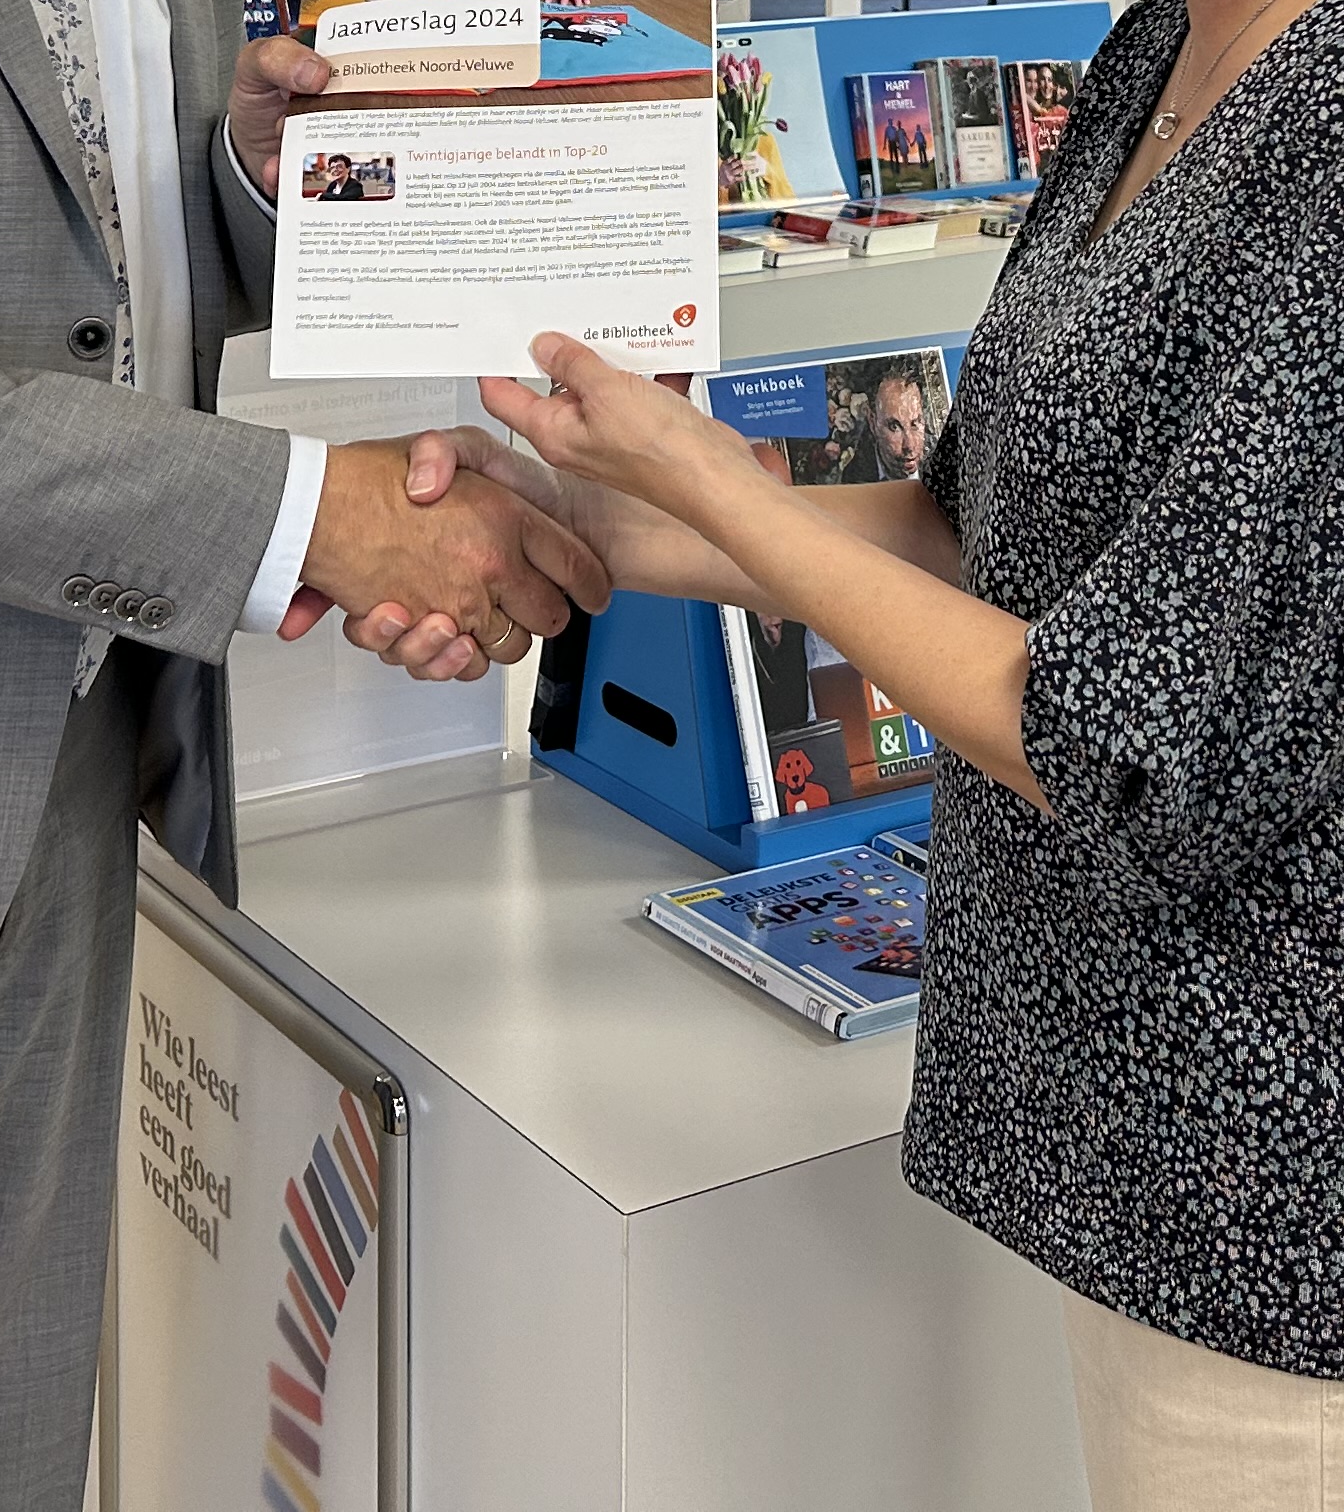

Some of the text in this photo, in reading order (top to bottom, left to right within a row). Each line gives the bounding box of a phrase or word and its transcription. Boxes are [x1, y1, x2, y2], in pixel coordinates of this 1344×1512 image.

[328, 8, 524, 41] Jaarverslag 2024
[343, 57, 416, 77] Bibliotheek
[420, 57, 515, 72] Noord-Veluwe
[885, 80, 911, 91] HART
[407, 144, 608, 164] Twintigjarige belandt in Top-20
[584, 324, 674, 340] de Bibliotheek
[627, 338, 695, 349] Noord-Veluwe
[732, 375, 805, 396] Werkboek
[880, 724, 902, 755] &
[717, 872, 836, 906] DE LEUKSTE
[746, 891, 860, 930] APPS
[138, 991, 240, 1123] Wie leest
[139, 1043, 194, 1131] heeft
[138, 1100, 232, 1220] een goed
[138, 1150, 220, 1263] verhaal
